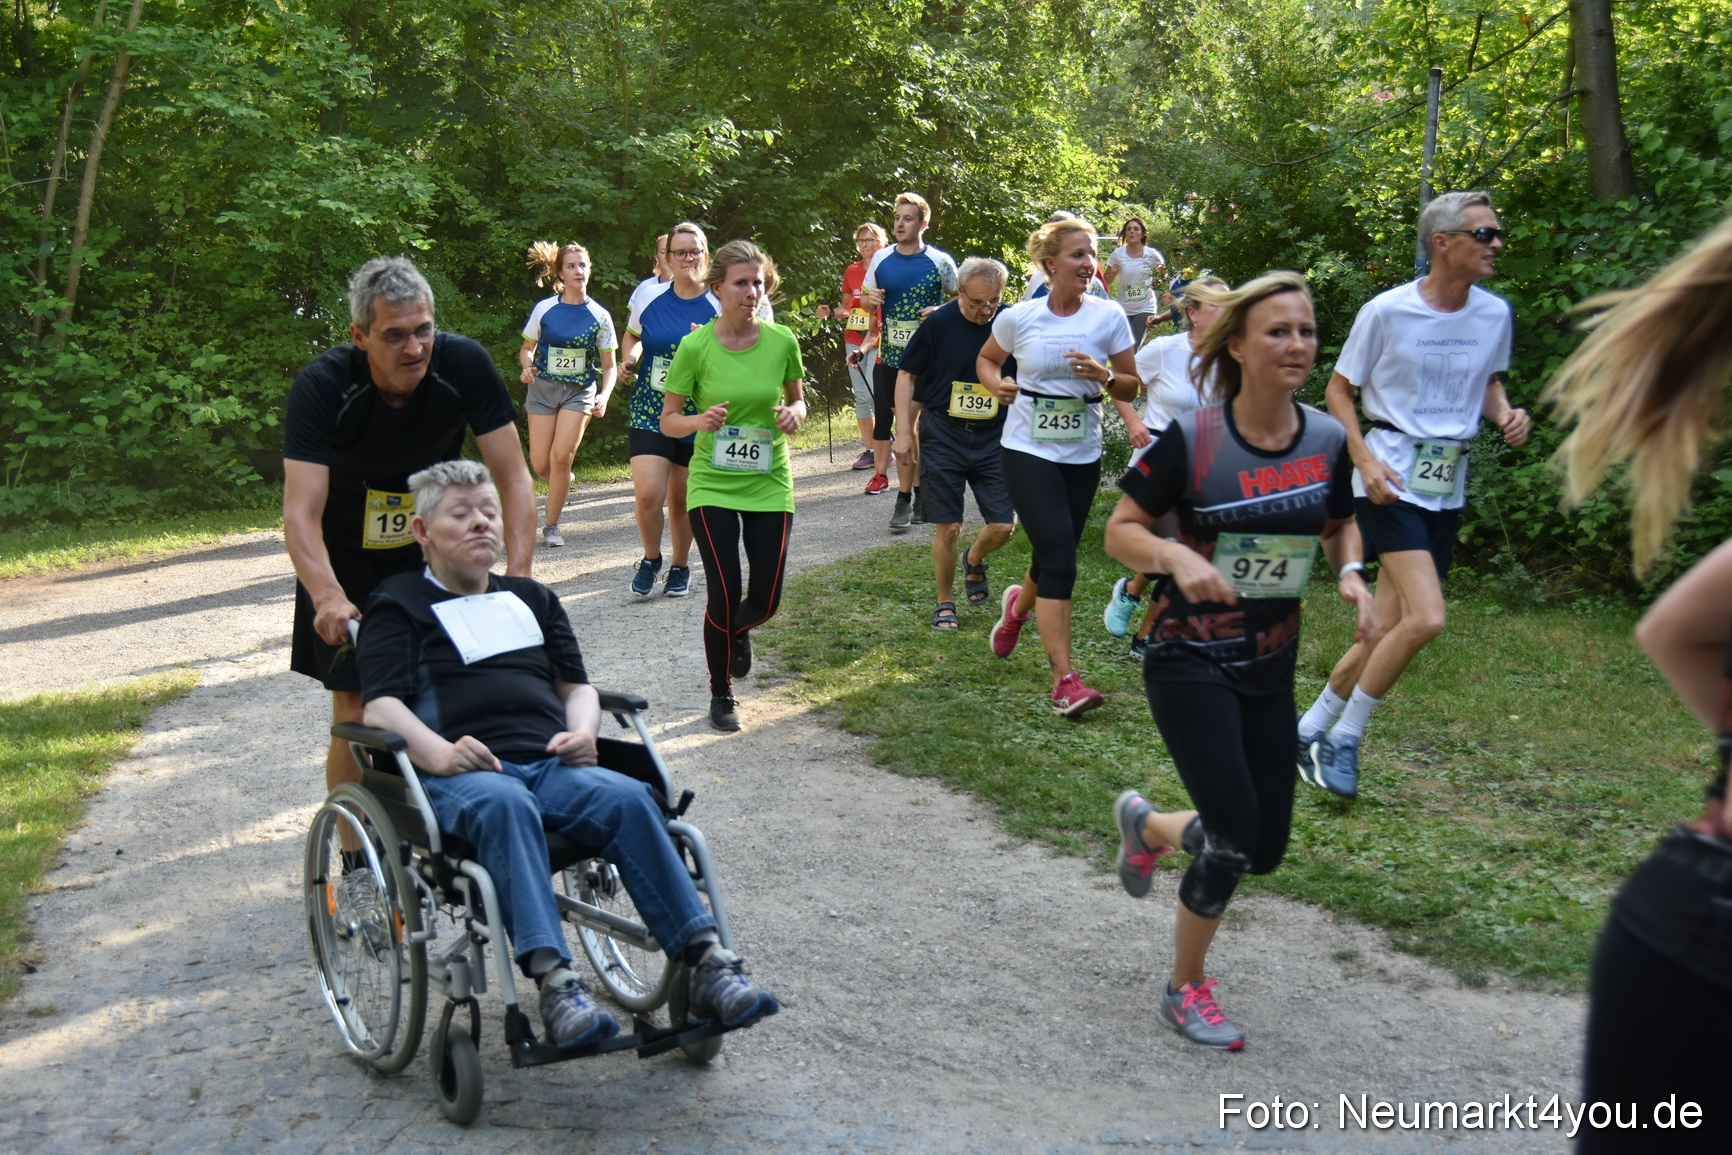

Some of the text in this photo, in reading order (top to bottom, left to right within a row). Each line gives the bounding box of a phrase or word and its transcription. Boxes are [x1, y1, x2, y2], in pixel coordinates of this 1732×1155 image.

[1128, 288, 1142, 298] 662
[892, 329, 912, 340] 257
[1415, 338, 1479, 347] ZAHNARZTPRAXIS
[556, 357, 577, 368] 221
[957, 395, 993, 410] 1394
[1037, 414, 1081, 430] 2435
[725, 442, 760, 460] 446
[1237, 453, 1332, 499] HAARE
[376, 511, 416, 533] 19
[1231, 557, 1289, 580] 974
